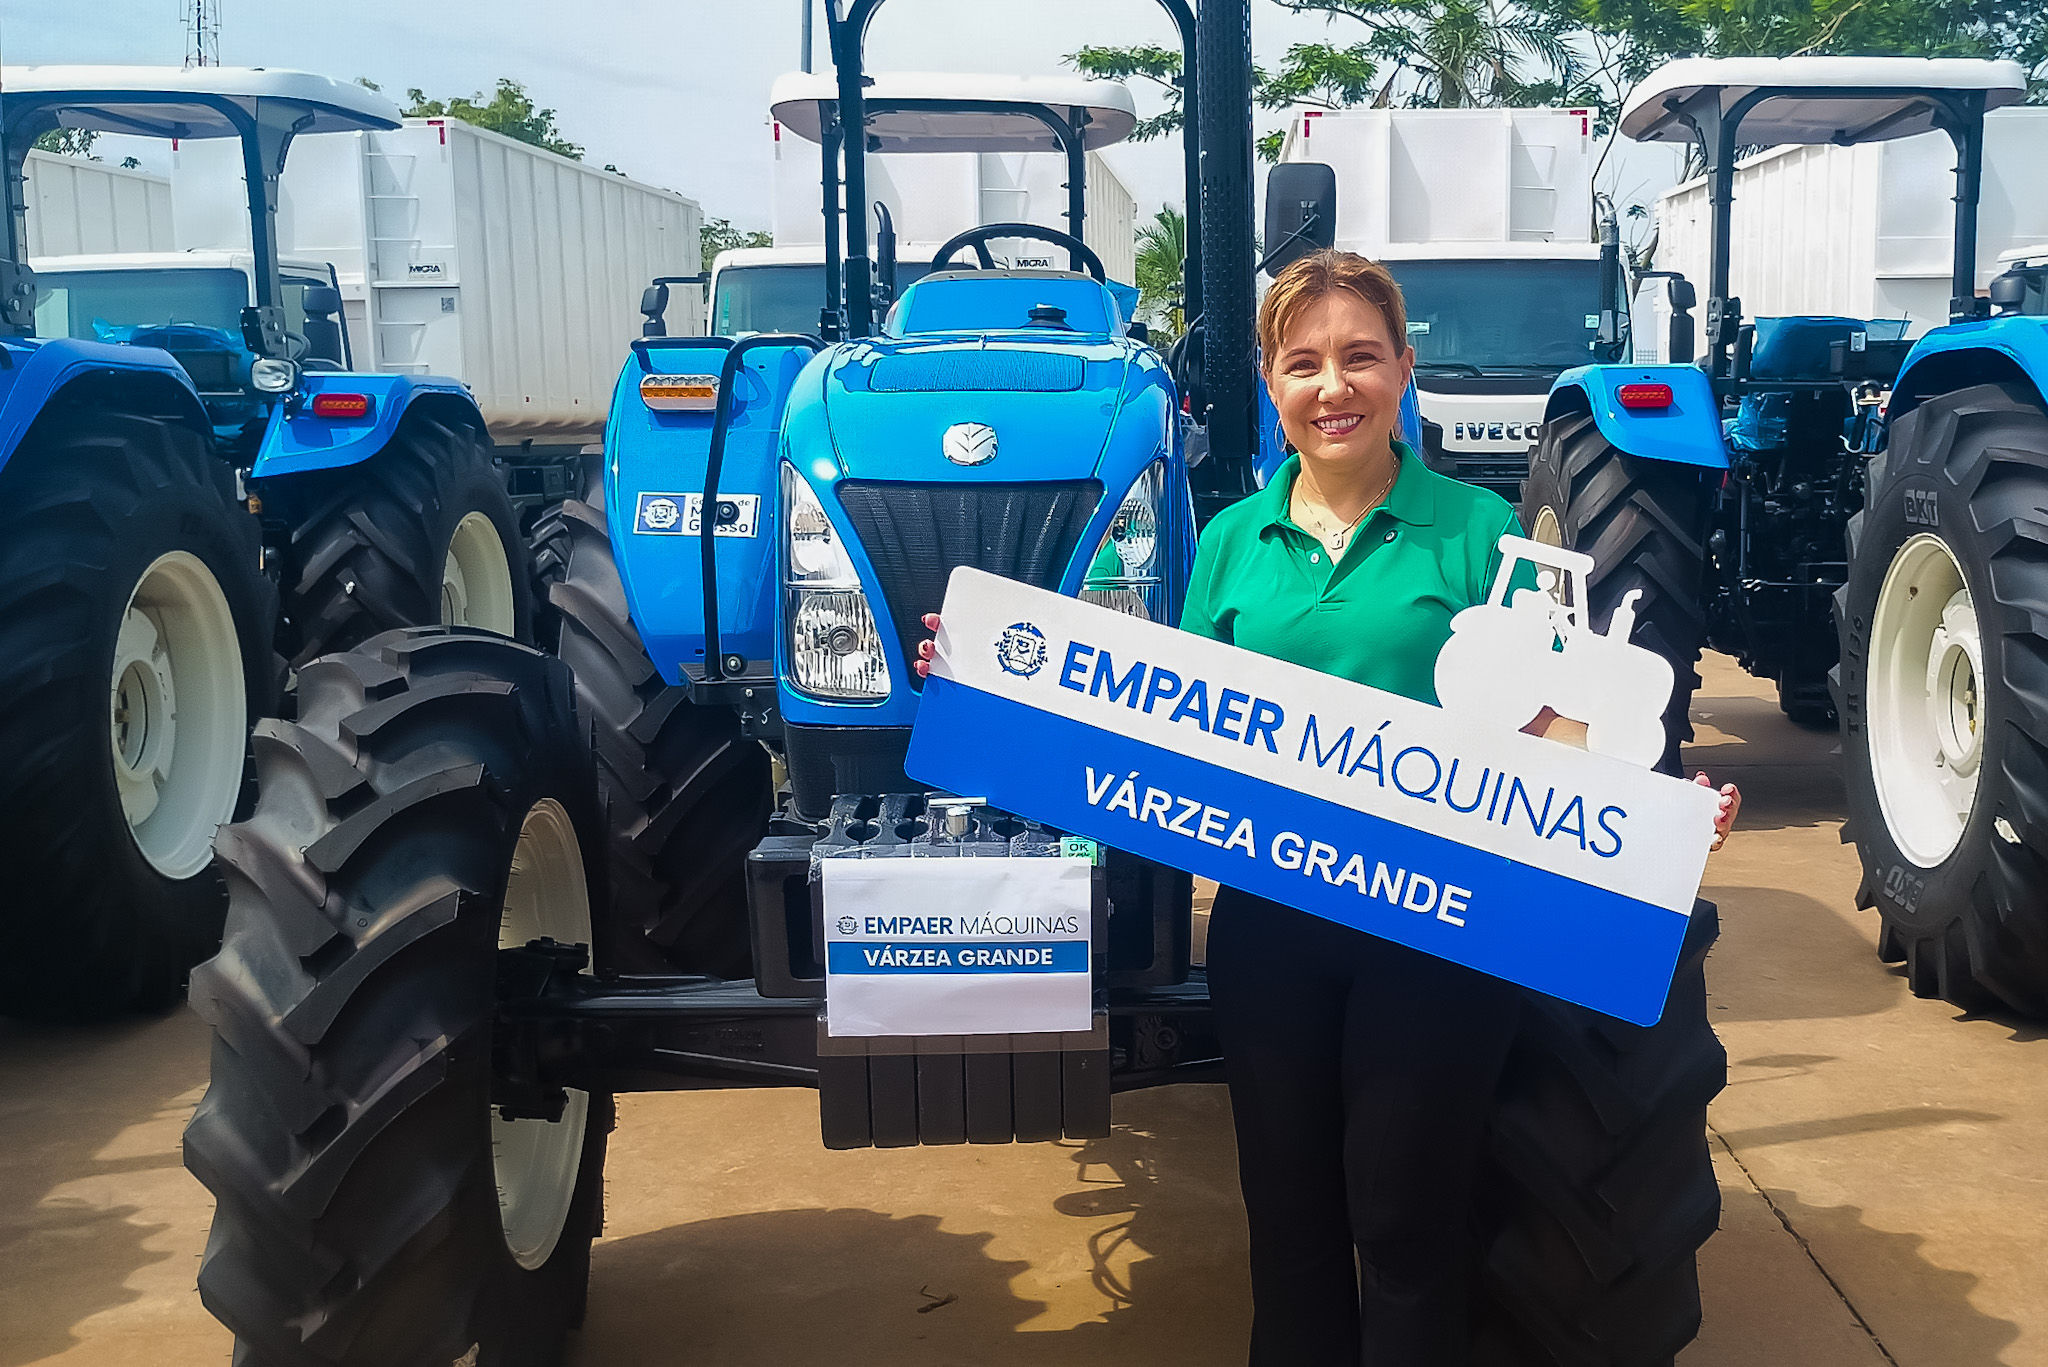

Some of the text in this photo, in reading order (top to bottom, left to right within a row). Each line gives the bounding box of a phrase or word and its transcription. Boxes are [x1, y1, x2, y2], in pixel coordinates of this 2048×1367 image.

[1455, 421, 1541, 441] IVECO
[1904, 489, 1939, 526] BKT
[1059, 640, 1627, 858] EMPAER MÁQUINAS
[1069, 843, 1089, 852] OK
[1085, 765, 1472, 927] VÁRZEA GRANDE
[865, 911, 1079, 935] EMPAER MÁQUINAS
[863, 945, 1053, 967] VÁRZEA GRANDE
